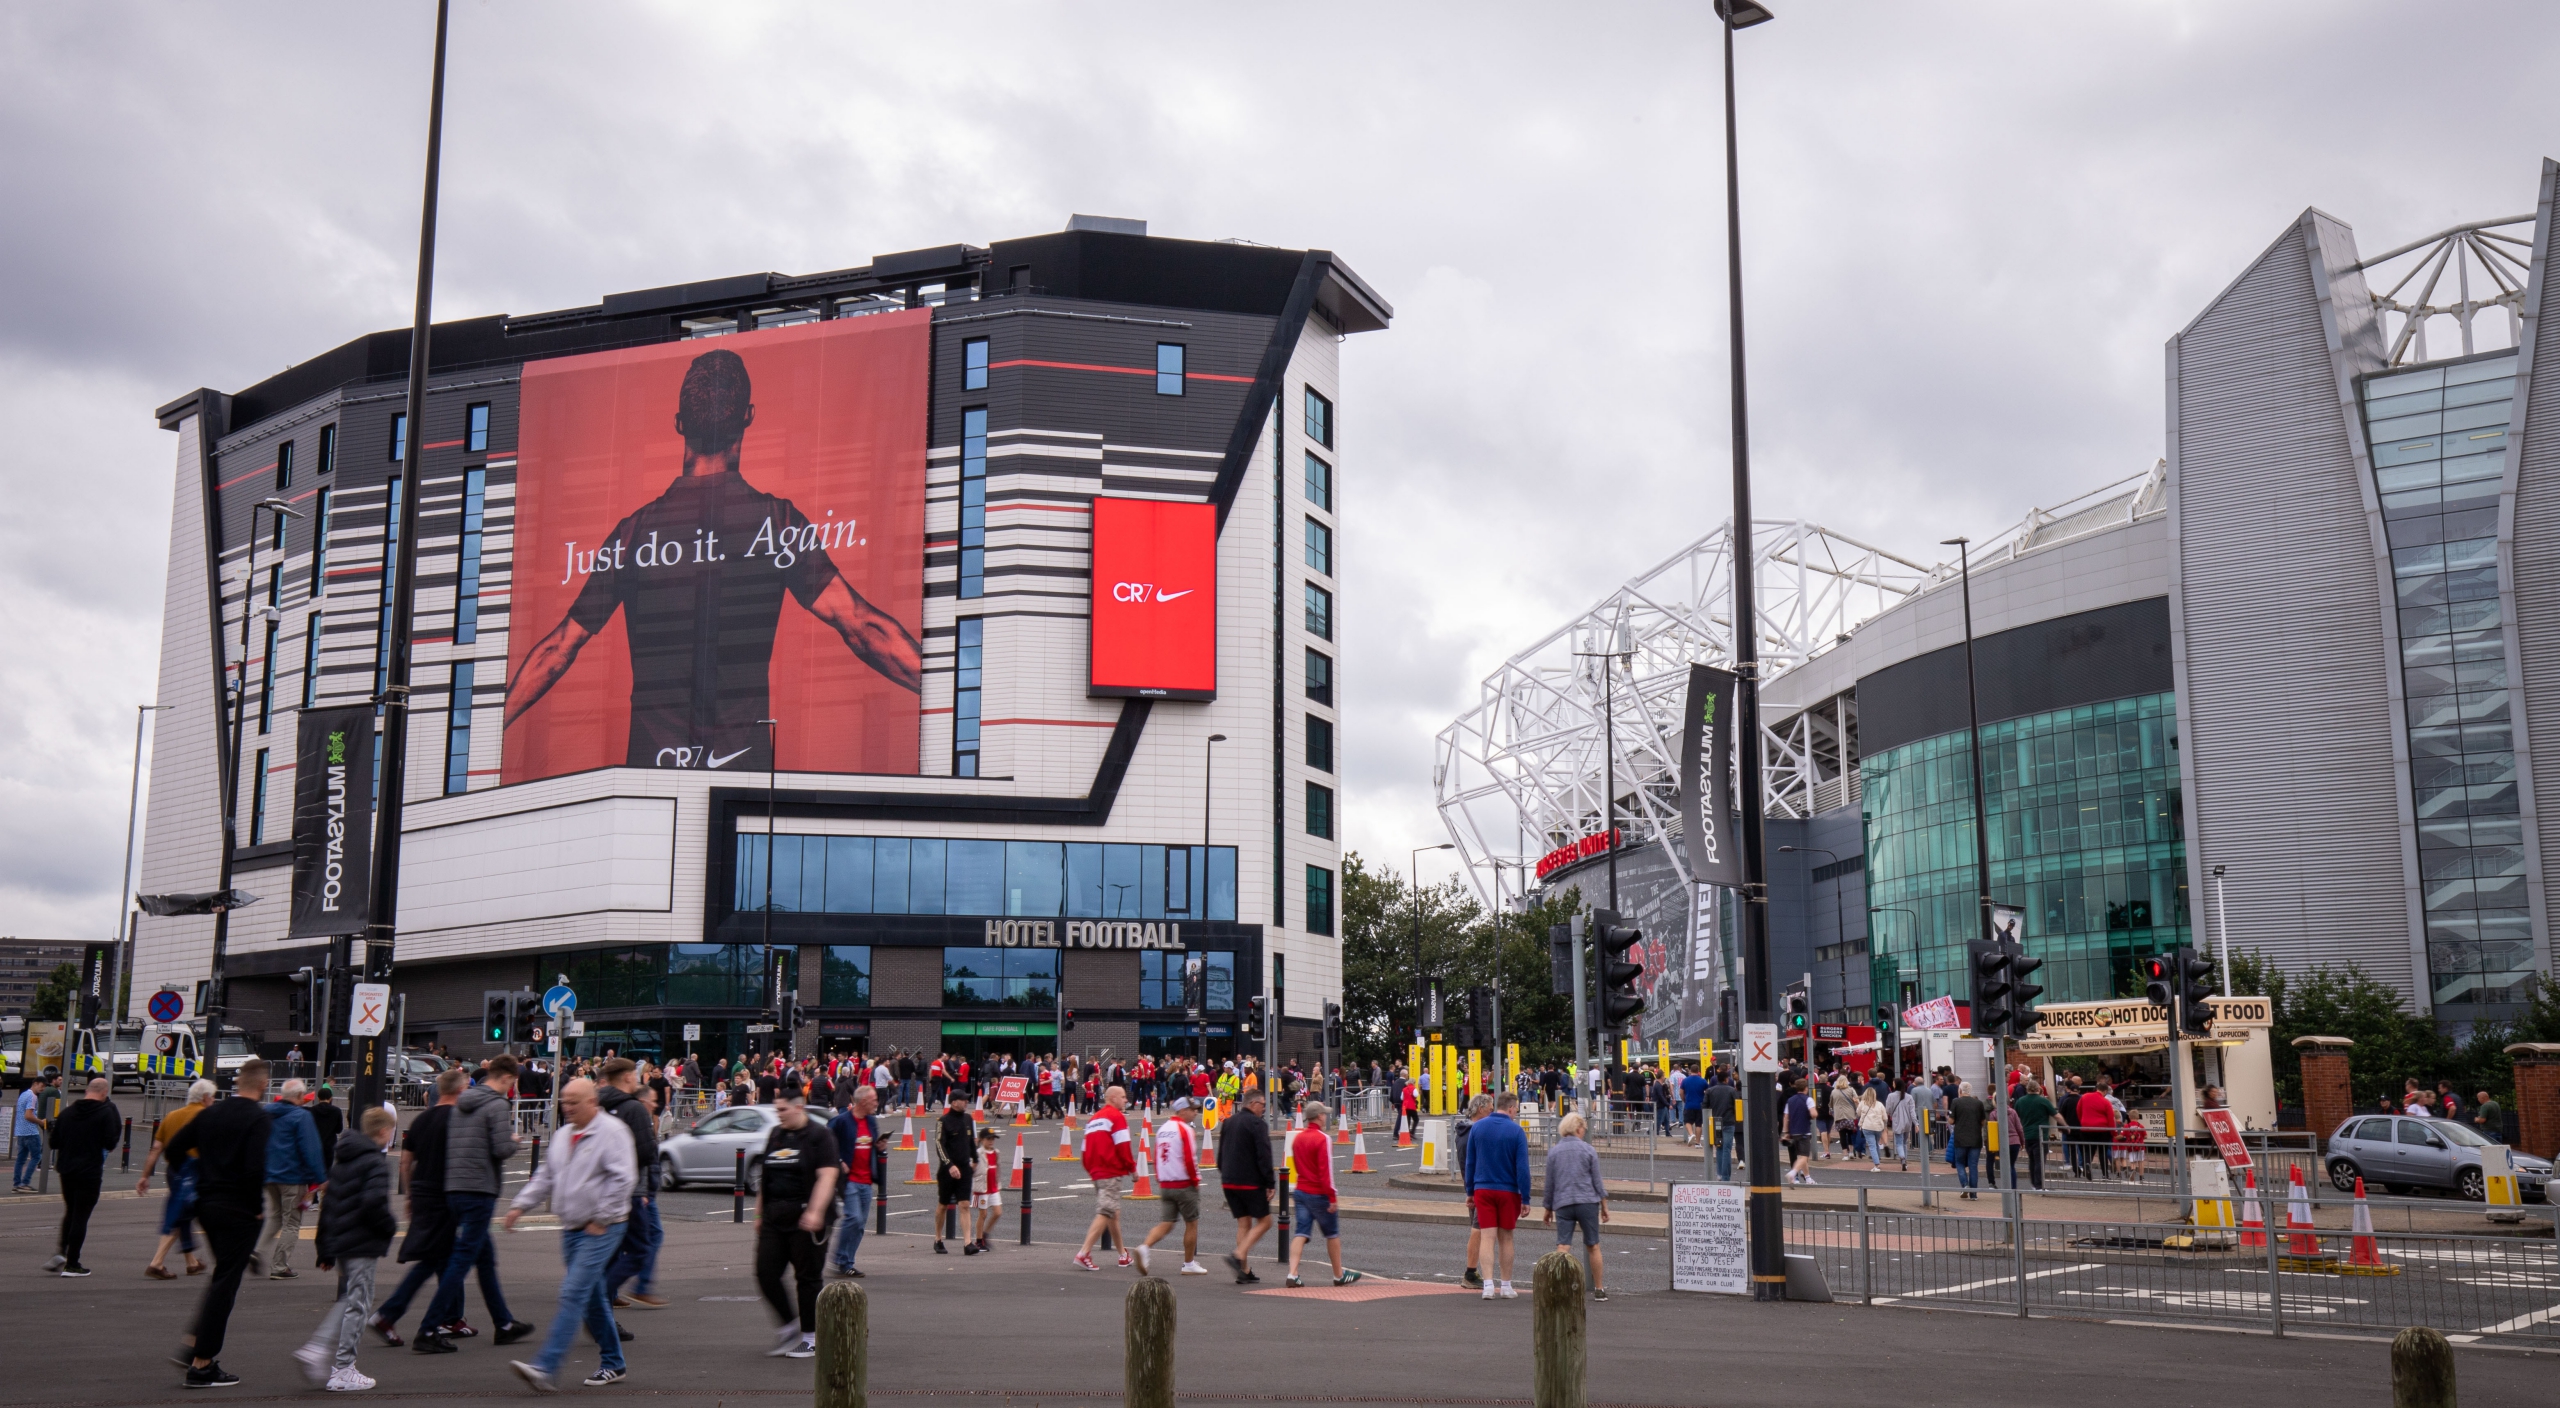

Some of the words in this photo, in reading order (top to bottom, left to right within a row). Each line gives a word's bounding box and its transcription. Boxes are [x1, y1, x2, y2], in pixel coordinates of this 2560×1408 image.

[562, 538, 626, 585] Just
[635, 531, 683, 568] do
[692, 528, 726, 563] it.
[744, 509, 867, 569] Again.
[1112, 582, 1153, 602] CR7
[656, 746, 703, 768] CR7
[1699, 725, 1720, 864] FOOTASYLUM
[323, 766, 346, 912] FOOTASYLUM
[985, 919, 1061, 947] HOTEL
[1065, 921, 1185, 949] FOOTBALL
[92, 960, 102, 997] OTASYLUM
[2040, 1010, 2094, 1027] BURGERS
[2113, 1007, 2138, 1024] HOT
[2141, 1006, 2168, 1022] DOG
[2223, 1004, 2265, 1020] FOOD
[2211, 1121, 2230, 1134] ROAD
[2220, 1142, 2243, 1157] CLOSED
[1675, 1195, 1698, 1203] DEVILS
[1677, 1188, 1709, 1196] SALFORD
[1718, 1188, 1731, 1197] RED
